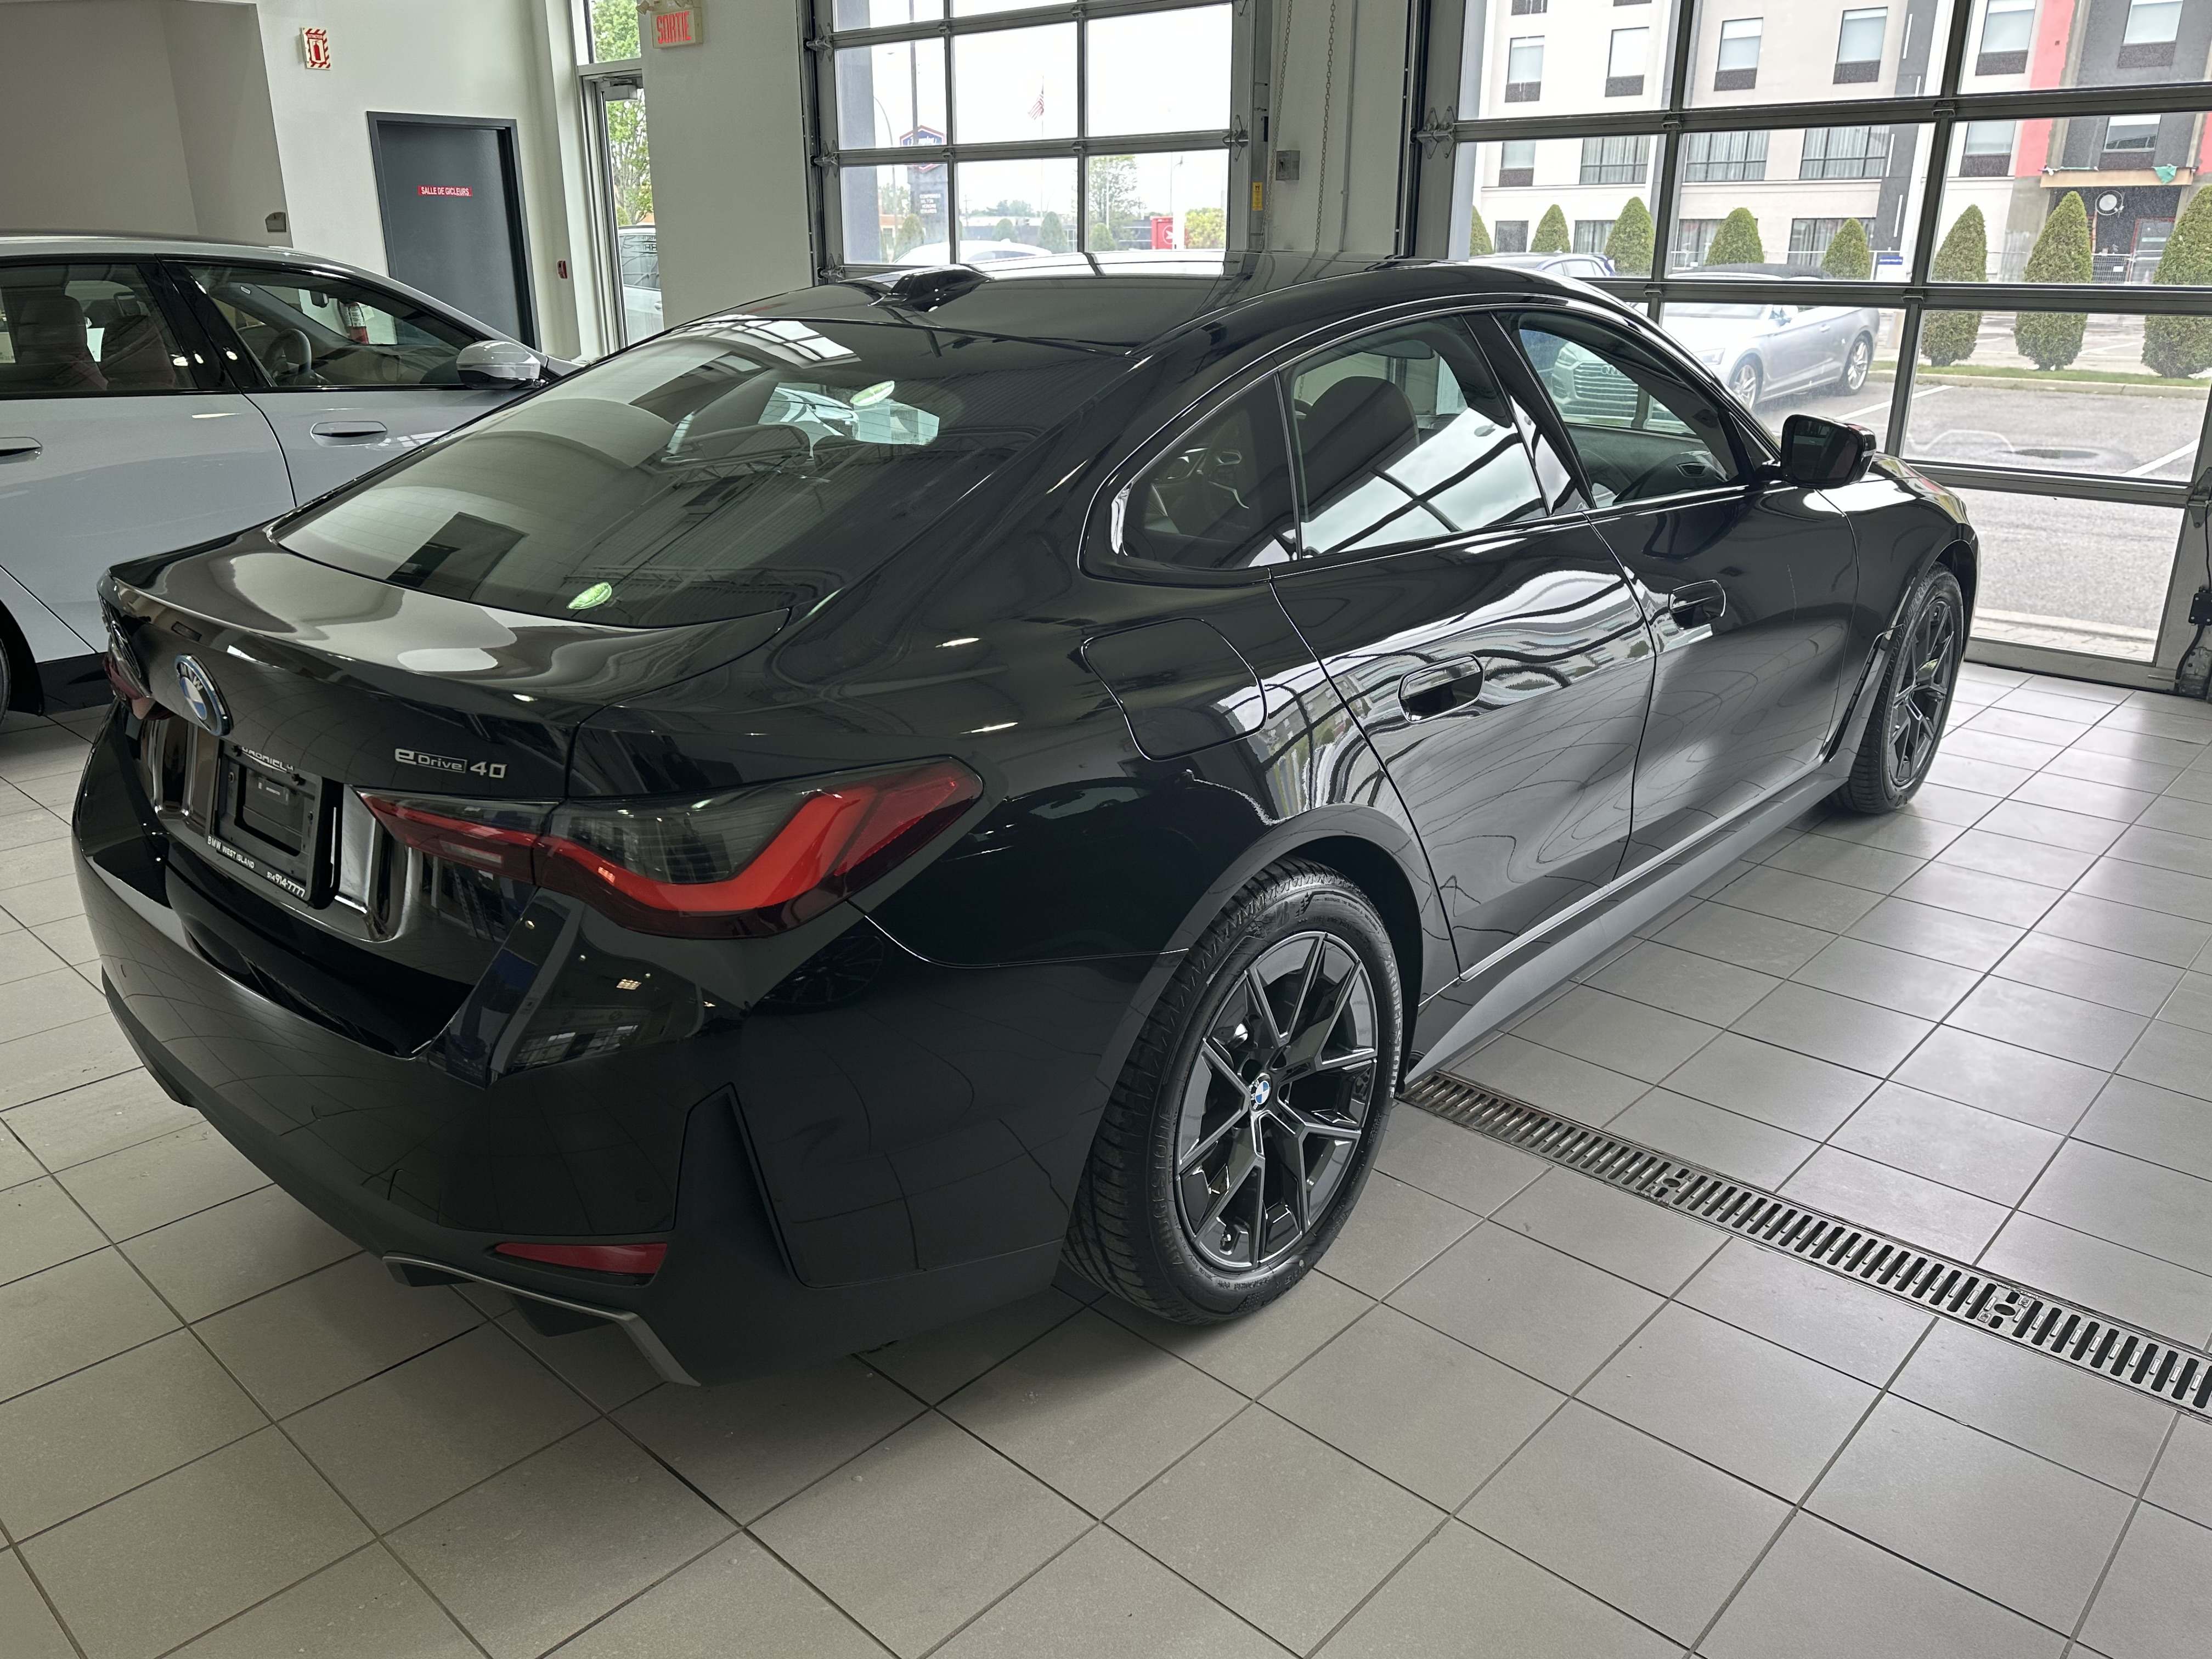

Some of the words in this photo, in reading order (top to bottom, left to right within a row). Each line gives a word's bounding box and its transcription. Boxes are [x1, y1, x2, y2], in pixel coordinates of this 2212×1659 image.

[656, 11, 691, 44] SORTIE
[421, 187, 437, 195] SALLE
[445, 187, 469, 196] GICLEURS
[179, 663, 204, 691] MW
[394, 748, 462, 771] eDrive
[470, 761, 507, 778] 40
[207, 836, 222, 850] BMW
[222, 845, 236, 859] WEST
[236, 853, 255, 869] ISLAND
[1250, 1079, 1260, 1110] BMW
